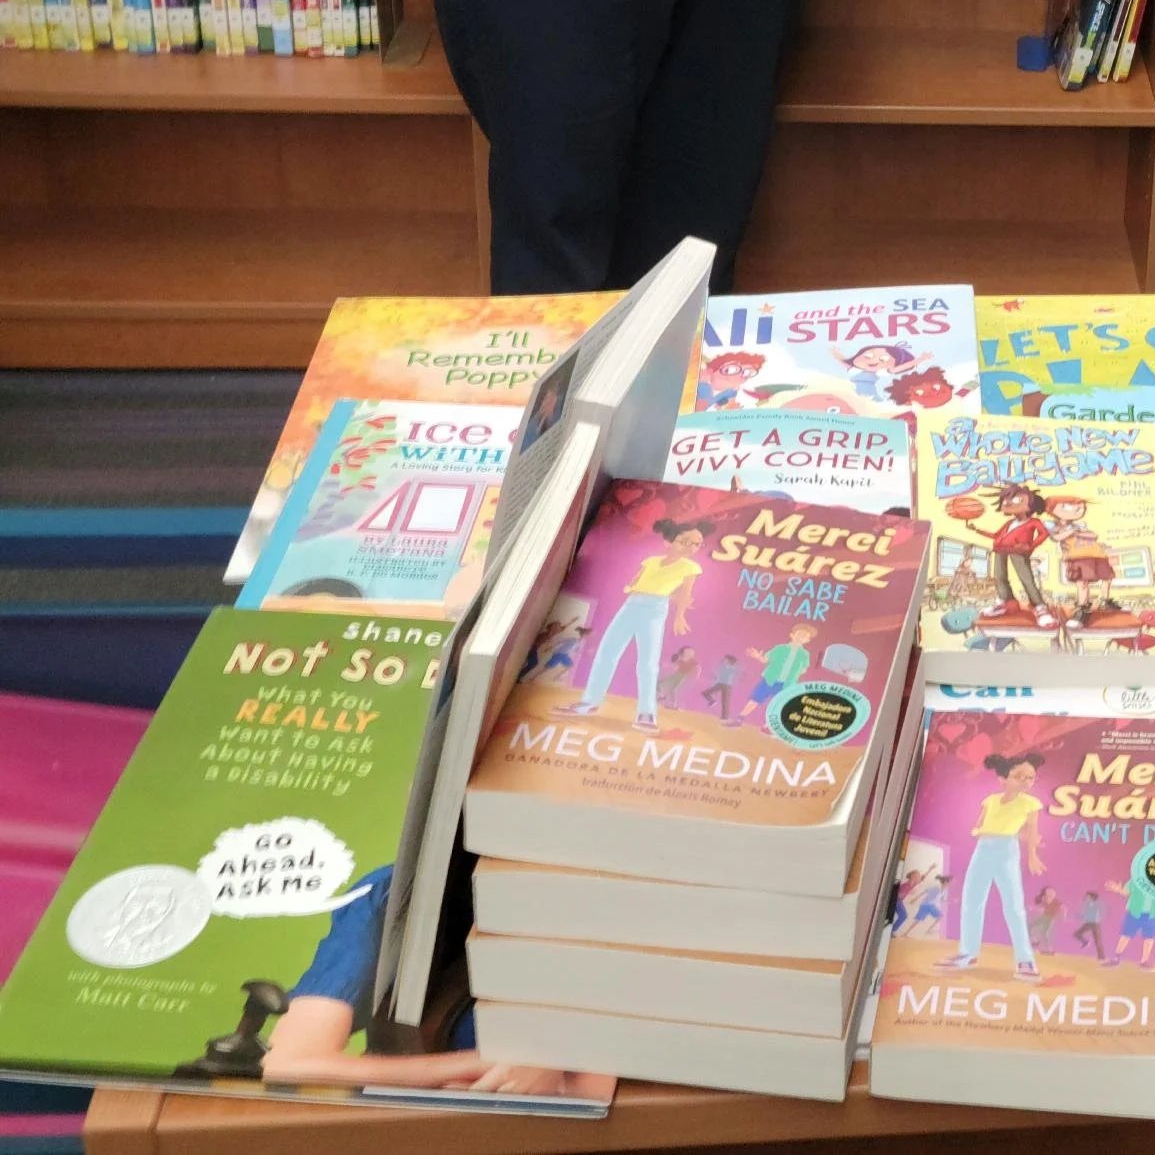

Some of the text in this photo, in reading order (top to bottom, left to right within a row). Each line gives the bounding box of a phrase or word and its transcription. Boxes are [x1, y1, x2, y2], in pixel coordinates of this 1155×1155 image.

[794, 298, 950, 320] and the SEA
[488, 330, 529, 349] I'll
[786, 312, 951, 344] STARS
[980, 323, 1129, 366] LET'S
[406, 349, 557, 369] Rememb
[445, 368, 541, 394] Popp
[671, 428, 893, 456] GET A GRIP,
[676, 450, 895, 476] VIVY COHEN!
[774, 473, 873, 489] Sarah Kapit
[745, 509, 898, 557] Merci
[710, 534, 896, 589] Suárez
[736, 569, 849, 606] NO SABE
[742, 589, 831, 623] BAILAR
[343, 620, 443, 646] shane
[257, 685, 374, 711] What You
[235, 699, 381, 734] REALLY
[218, 725, 374, 754] Want to Ask
[200, 743, 374, 777] About Having
[509, 722, 837, 787] MEG MEDINA
[1060, 821, 1131, 845] CAN'T
[216, 874, 323, 901] Ask Me
[897, 985, 1008, 1019] MEG
